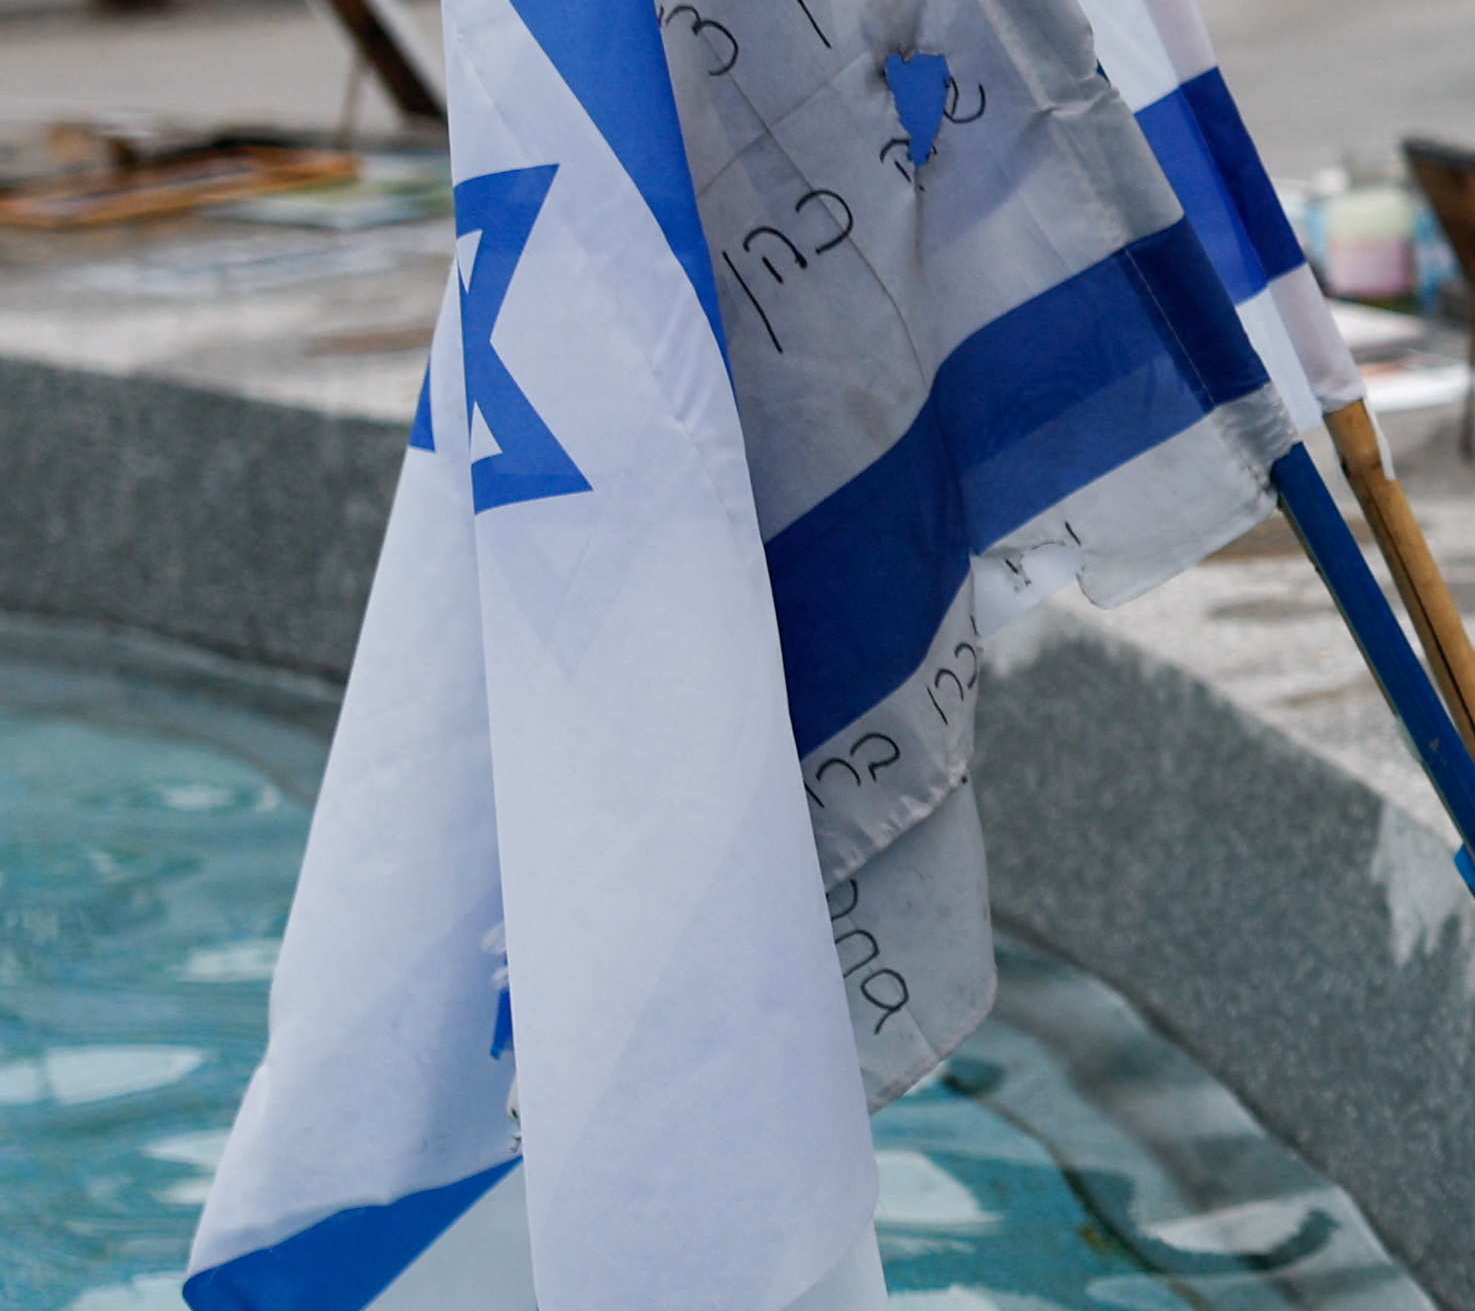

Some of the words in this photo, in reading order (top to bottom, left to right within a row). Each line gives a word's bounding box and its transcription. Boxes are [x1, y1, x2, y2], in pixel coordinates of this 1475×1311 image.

[722, 190, 854, 355] כהן
[926, 615, 982, 726] כרו
[803, 732, 900, 810] ברו
